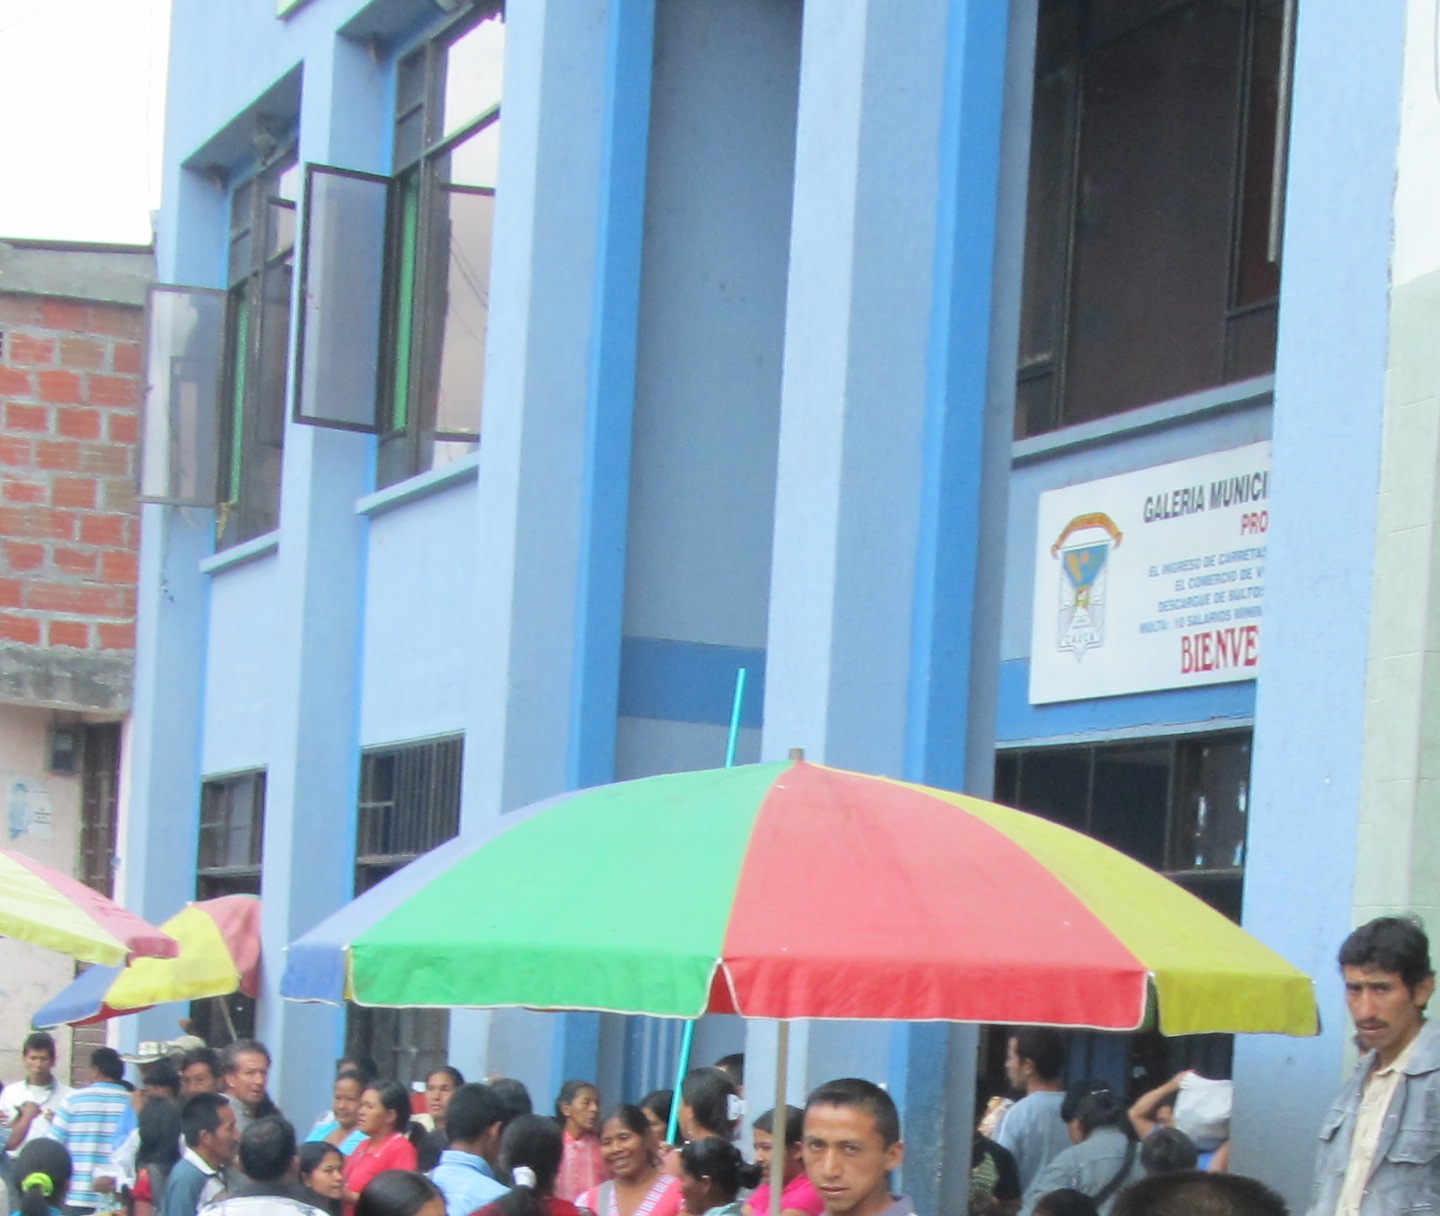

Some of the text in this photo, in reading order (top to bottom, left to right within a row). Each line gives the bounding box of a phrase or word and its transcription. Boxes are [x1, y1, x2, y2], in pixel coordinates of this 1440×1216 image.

[1144, 470, 1268, 523] GALERIA MUNICI
[1240, 510, 1269, 536] PRO
[1181, 625, 1258, 674] BIENVE
